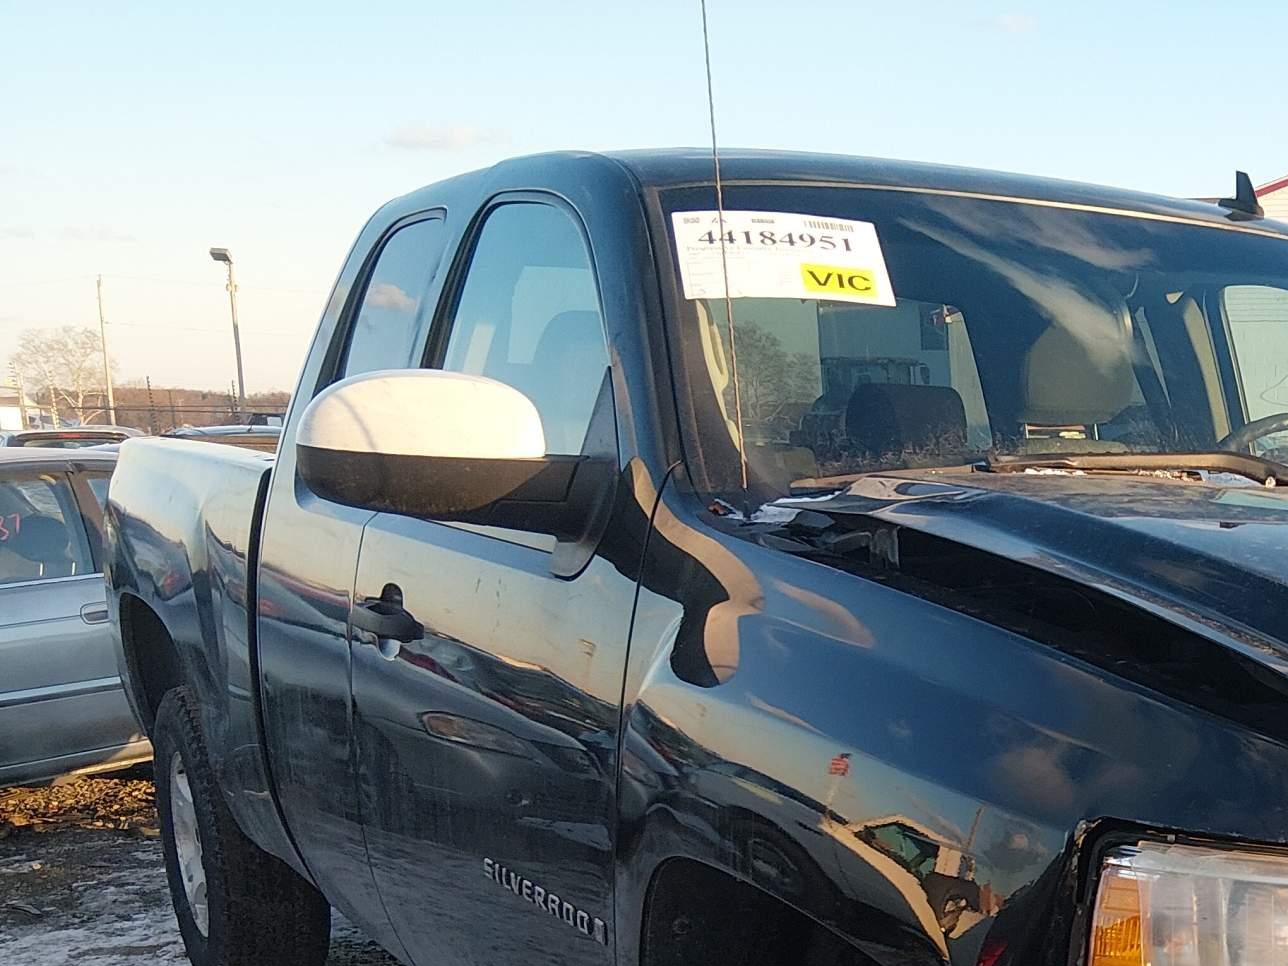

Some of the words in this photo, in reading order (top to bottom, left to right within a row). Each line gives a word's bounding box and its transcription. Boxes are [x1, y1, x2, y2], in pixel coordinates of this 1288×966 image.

[697, 229, 853, 252] 44184951
[806, 270, 873, 292] VIC
[483, 856, 590, 935] SILVERADO
